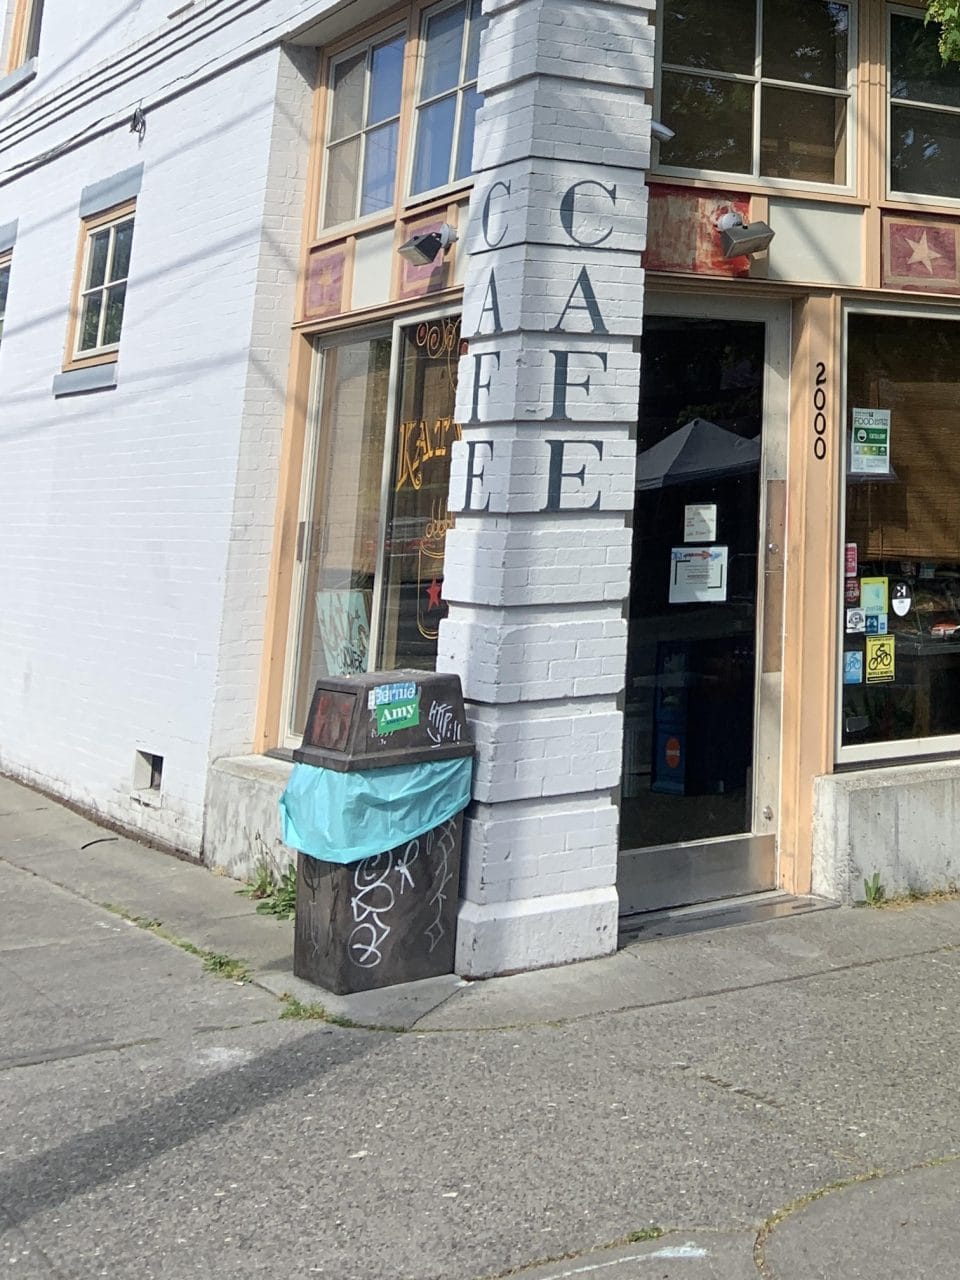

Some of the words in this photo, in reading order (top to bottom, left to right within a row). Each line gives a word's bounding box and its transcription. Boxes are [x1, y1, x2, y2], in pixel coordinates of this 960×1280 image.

[539, 180, 618, 513] CAFE
[814, 362, 827, 460] 2000
[381, 704, 416, 723] Amy
